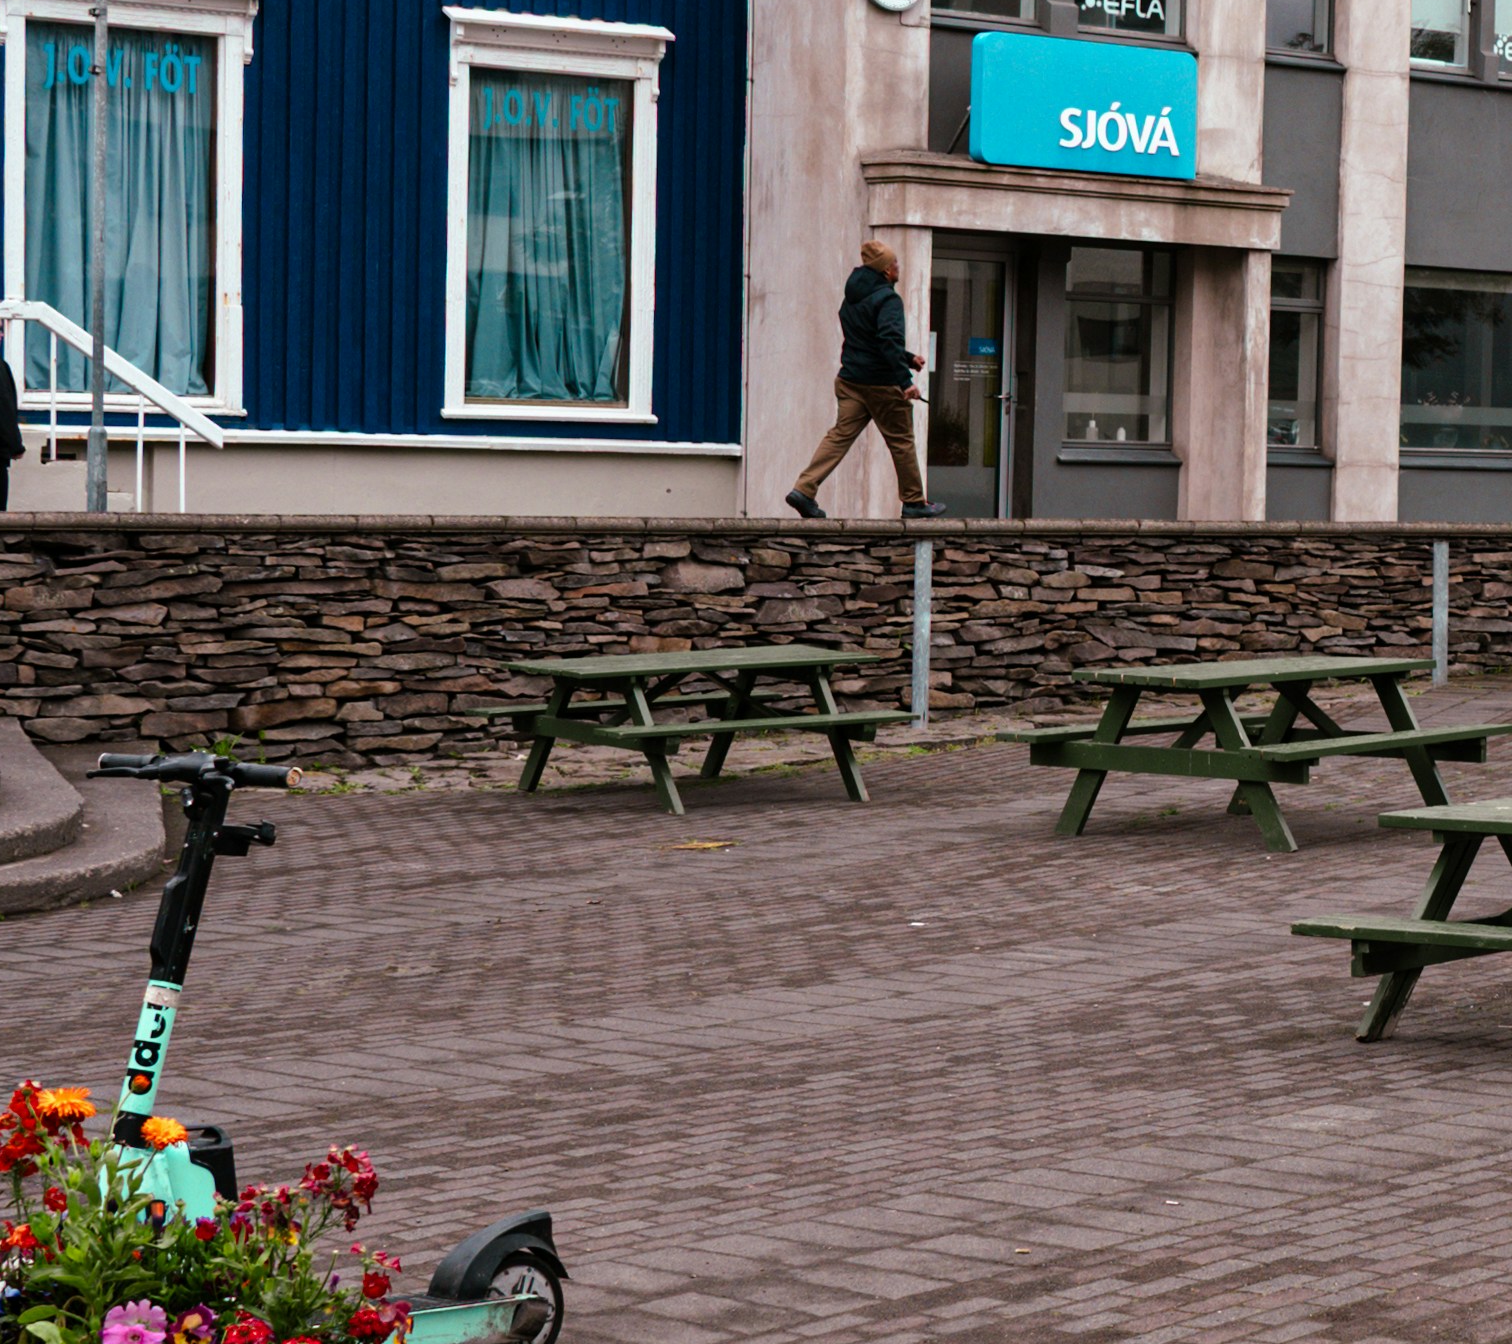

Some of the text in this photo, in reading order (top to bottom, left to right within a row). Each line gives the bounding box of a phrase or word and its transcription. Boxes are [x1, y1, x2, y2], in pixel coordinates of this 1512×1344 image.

[43, 40, 202, 95] J.OV. FÖT
[483, 86, 620, 133] J.O.V. FÖT
[1059, 102, 1181, 157] SJÓVÁ
